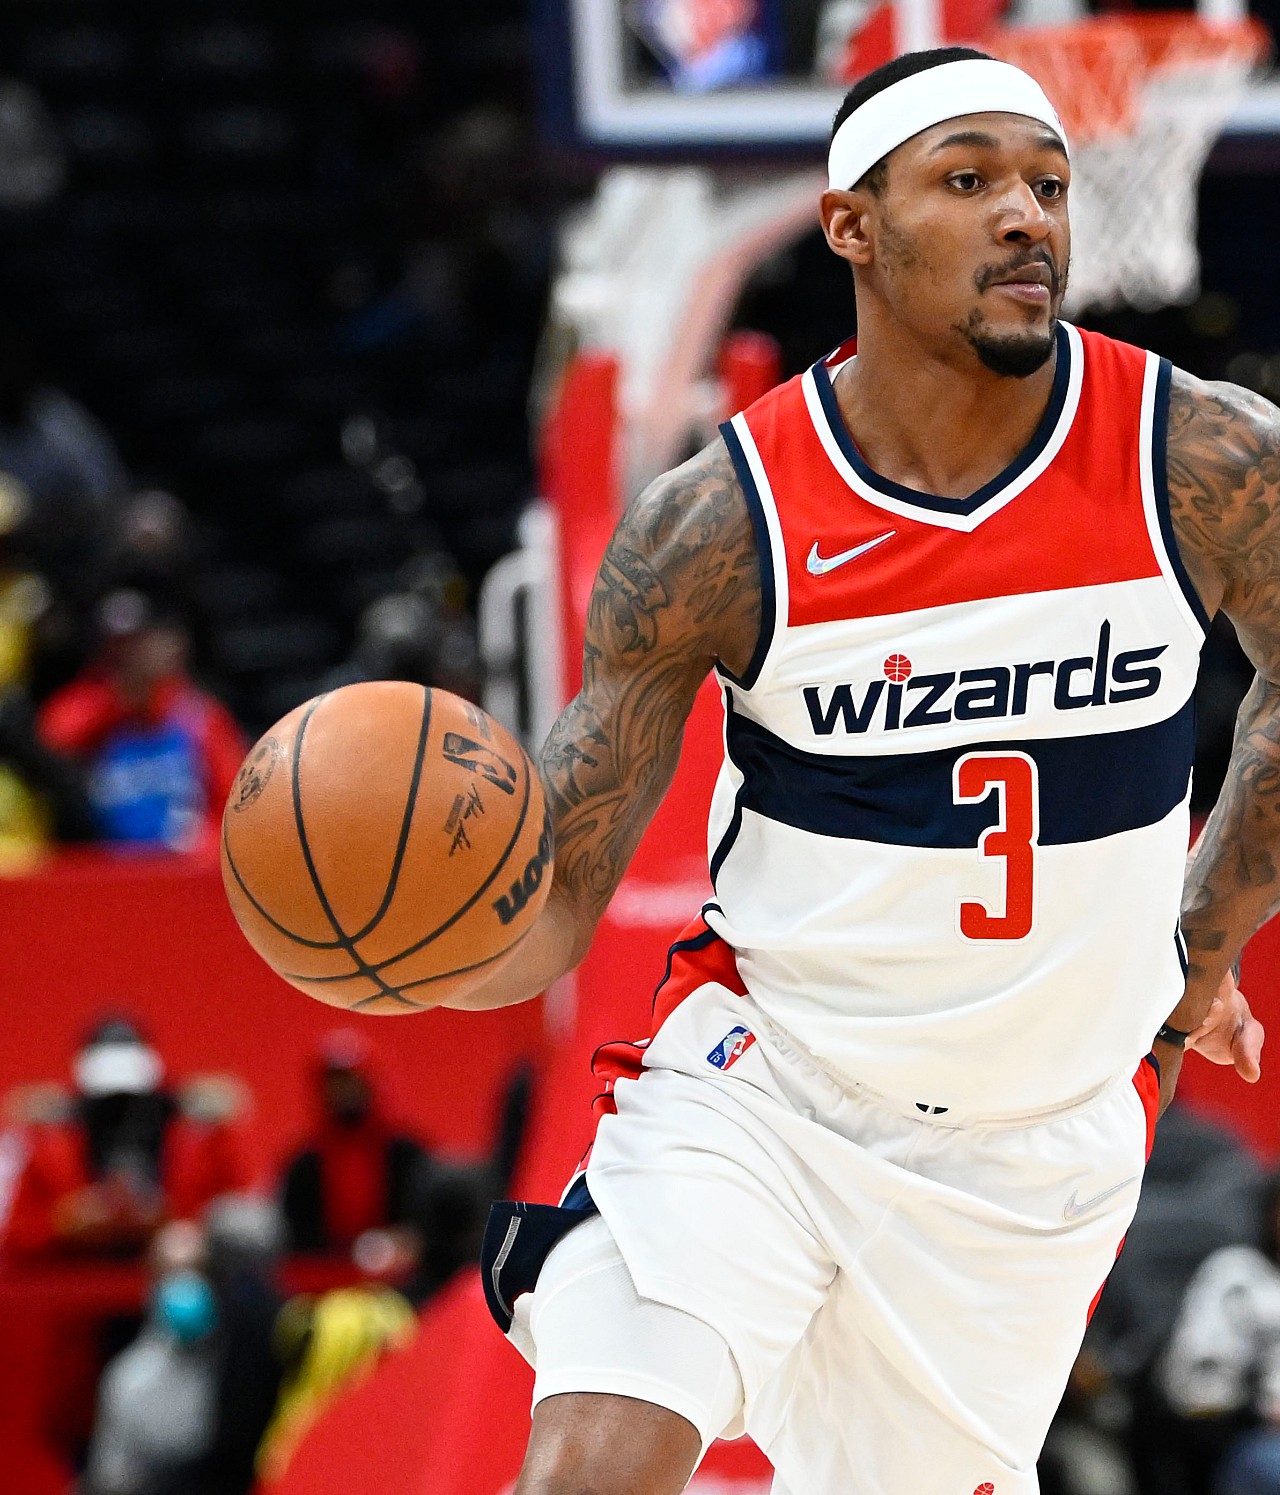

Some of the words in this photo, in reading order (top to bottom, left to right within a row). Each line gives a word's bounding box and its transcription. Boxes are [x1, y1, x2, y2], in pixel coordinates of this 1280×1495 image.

[803, 619, 1169, 735] wizards
[953, 752, 1038, 943] 3
[710, 1051, 724, 1064] 75
